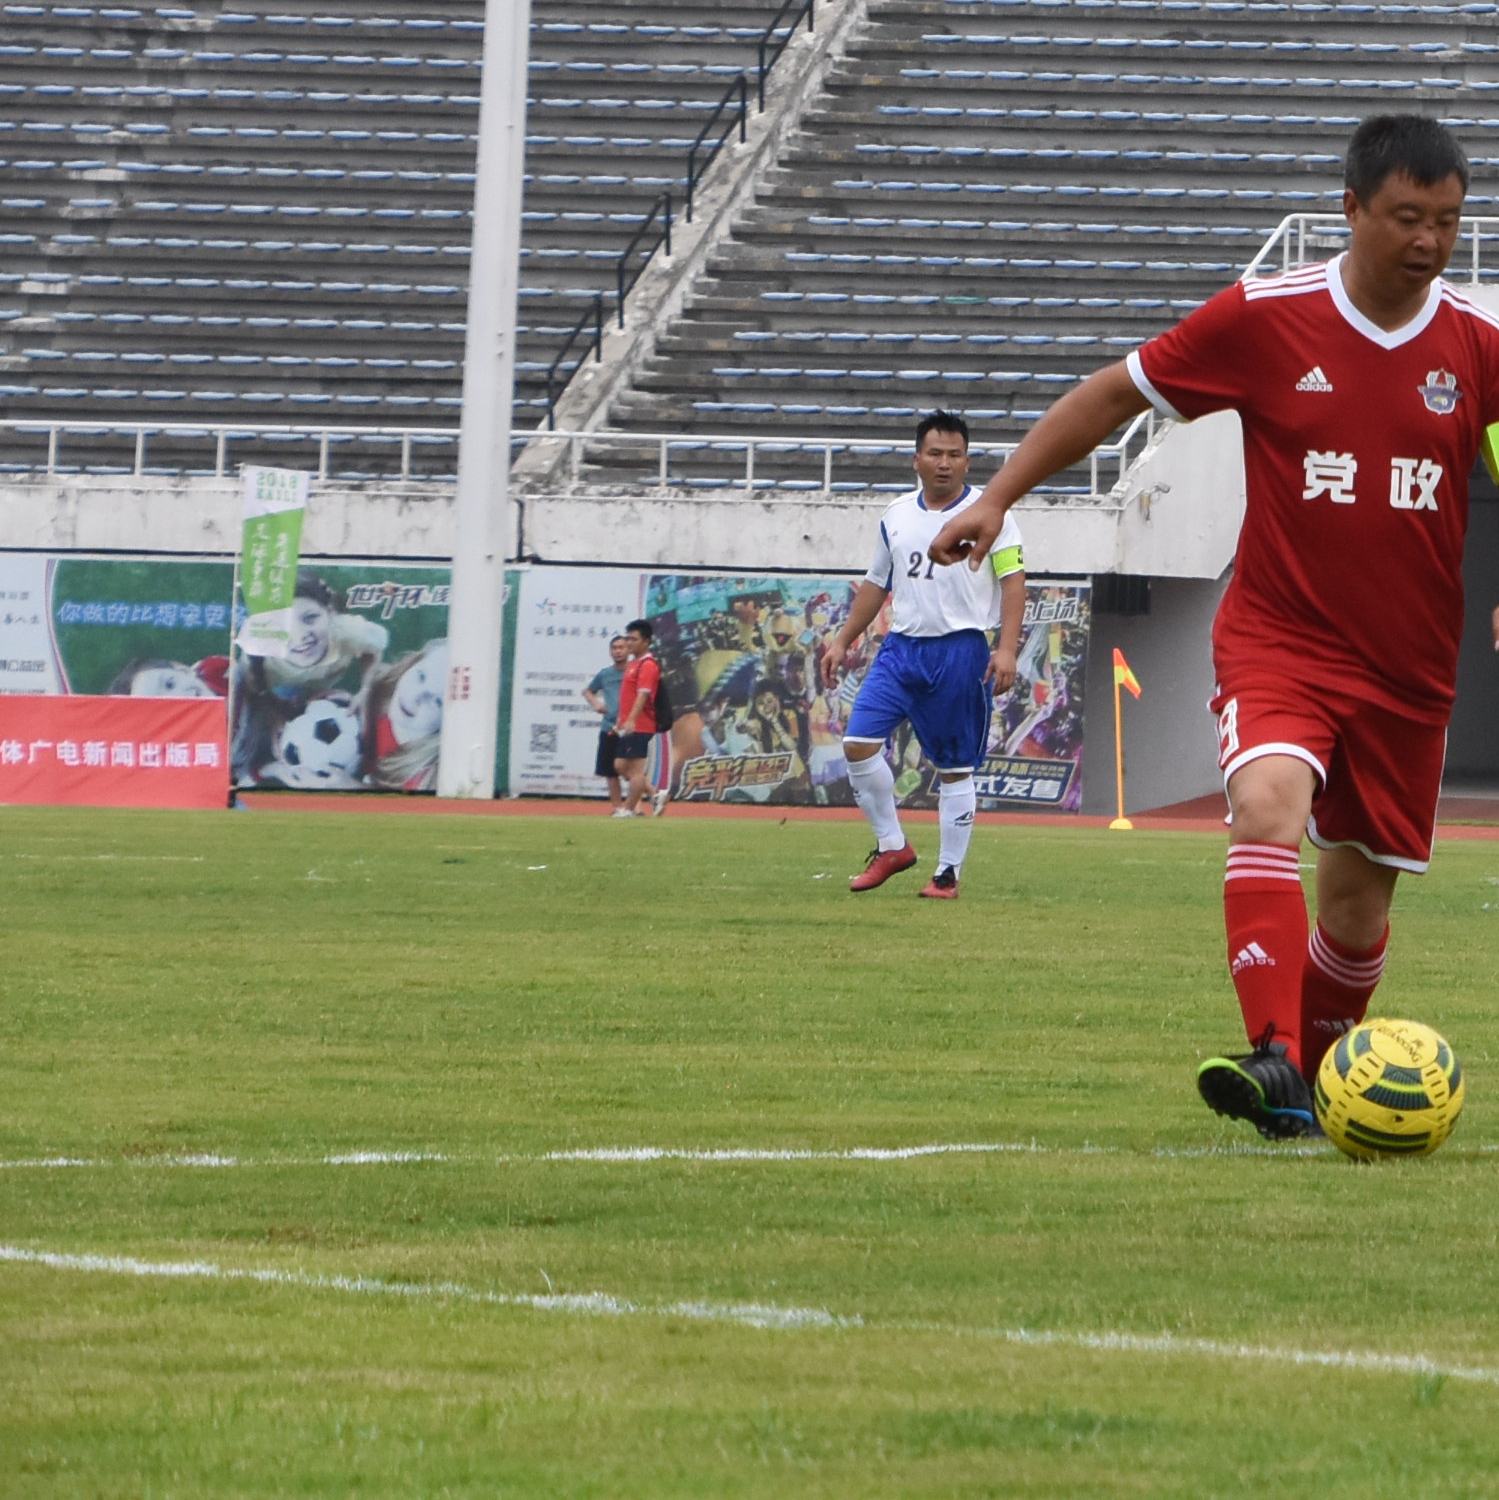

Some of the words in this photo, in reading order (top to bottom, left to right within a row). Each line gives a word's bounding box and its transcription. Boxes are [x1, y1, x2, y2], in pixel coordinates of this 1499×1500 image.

[1296, 382, 1333, 392] adidas
[1303, 450, 1443, 511] 党政
[907, 551, 935, 580] 21
[0, 739, 219, 768] 体广电新闻出版局
